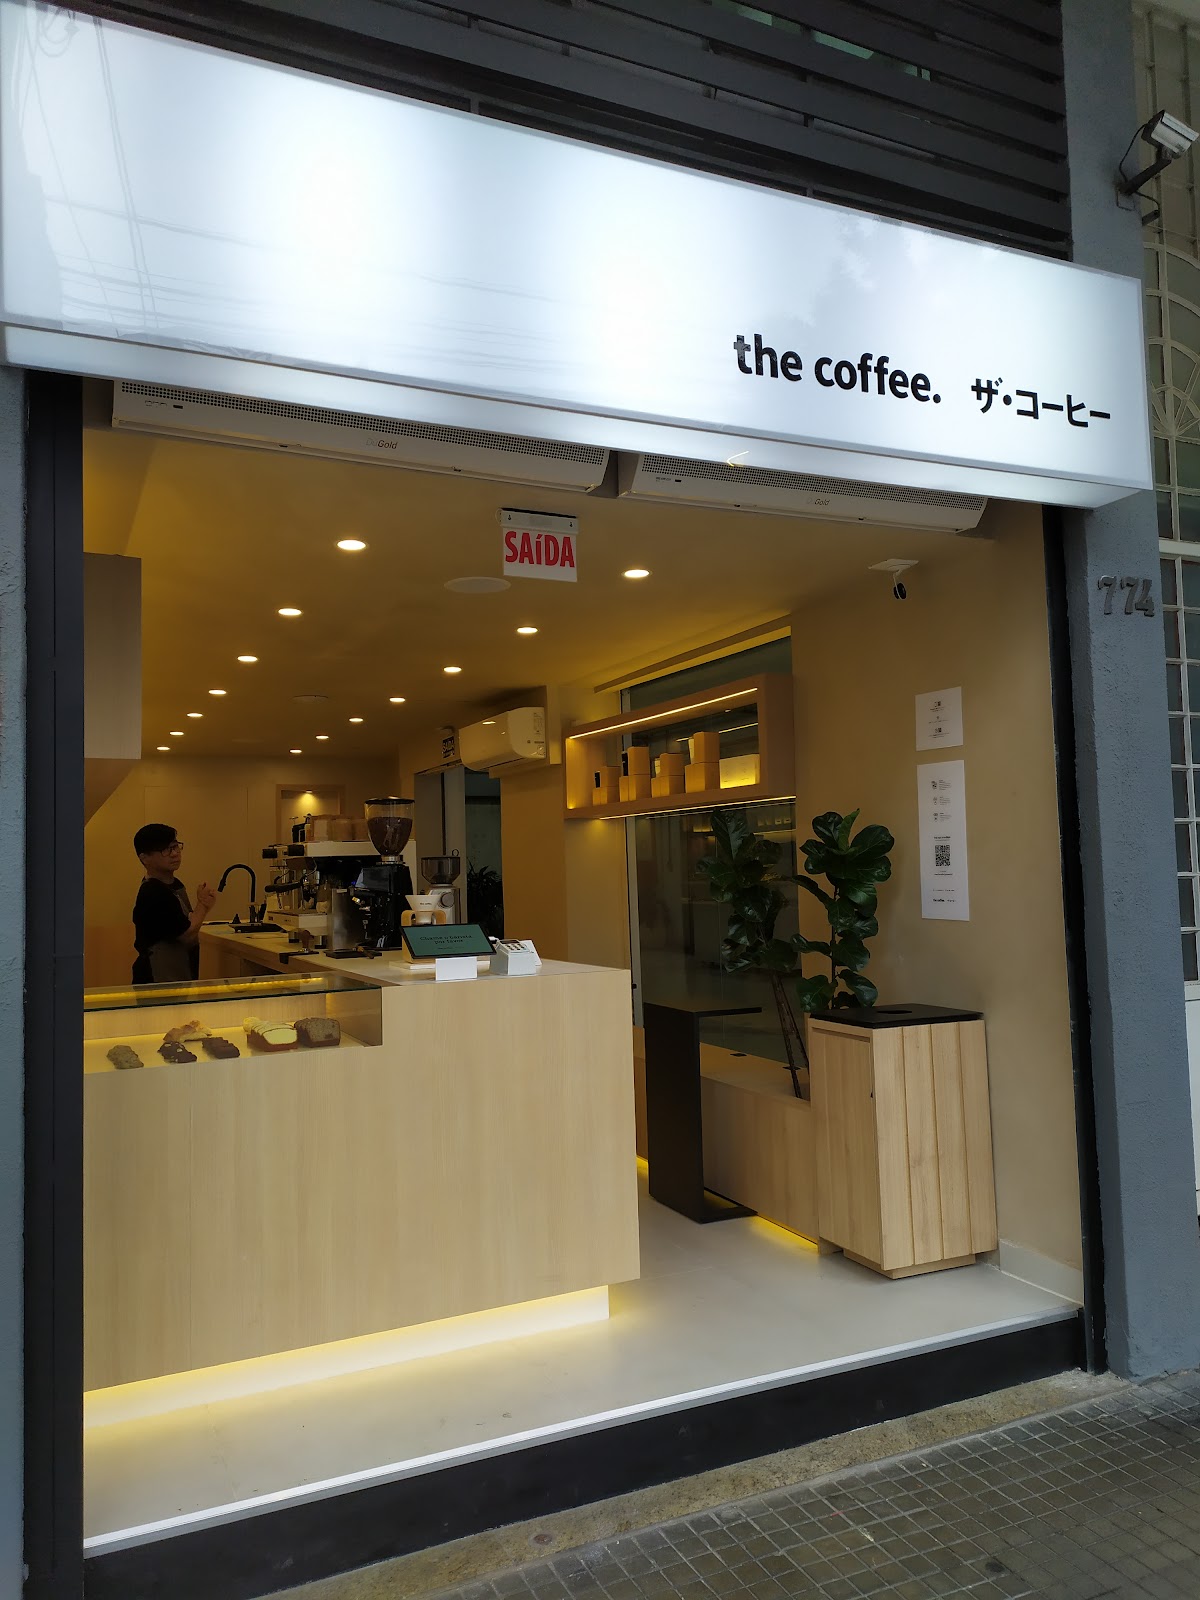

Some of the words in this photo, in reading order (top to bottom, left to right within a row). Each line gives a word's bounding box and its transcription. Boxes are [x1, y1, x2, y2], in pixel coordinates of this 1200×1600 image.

[733, 333, 803, 381] the
[814, 352, 942, 404] coffee.
[971, 376, 1111, 428] ザ・コーヒー
[1097, 574, 1155, 617] 774
